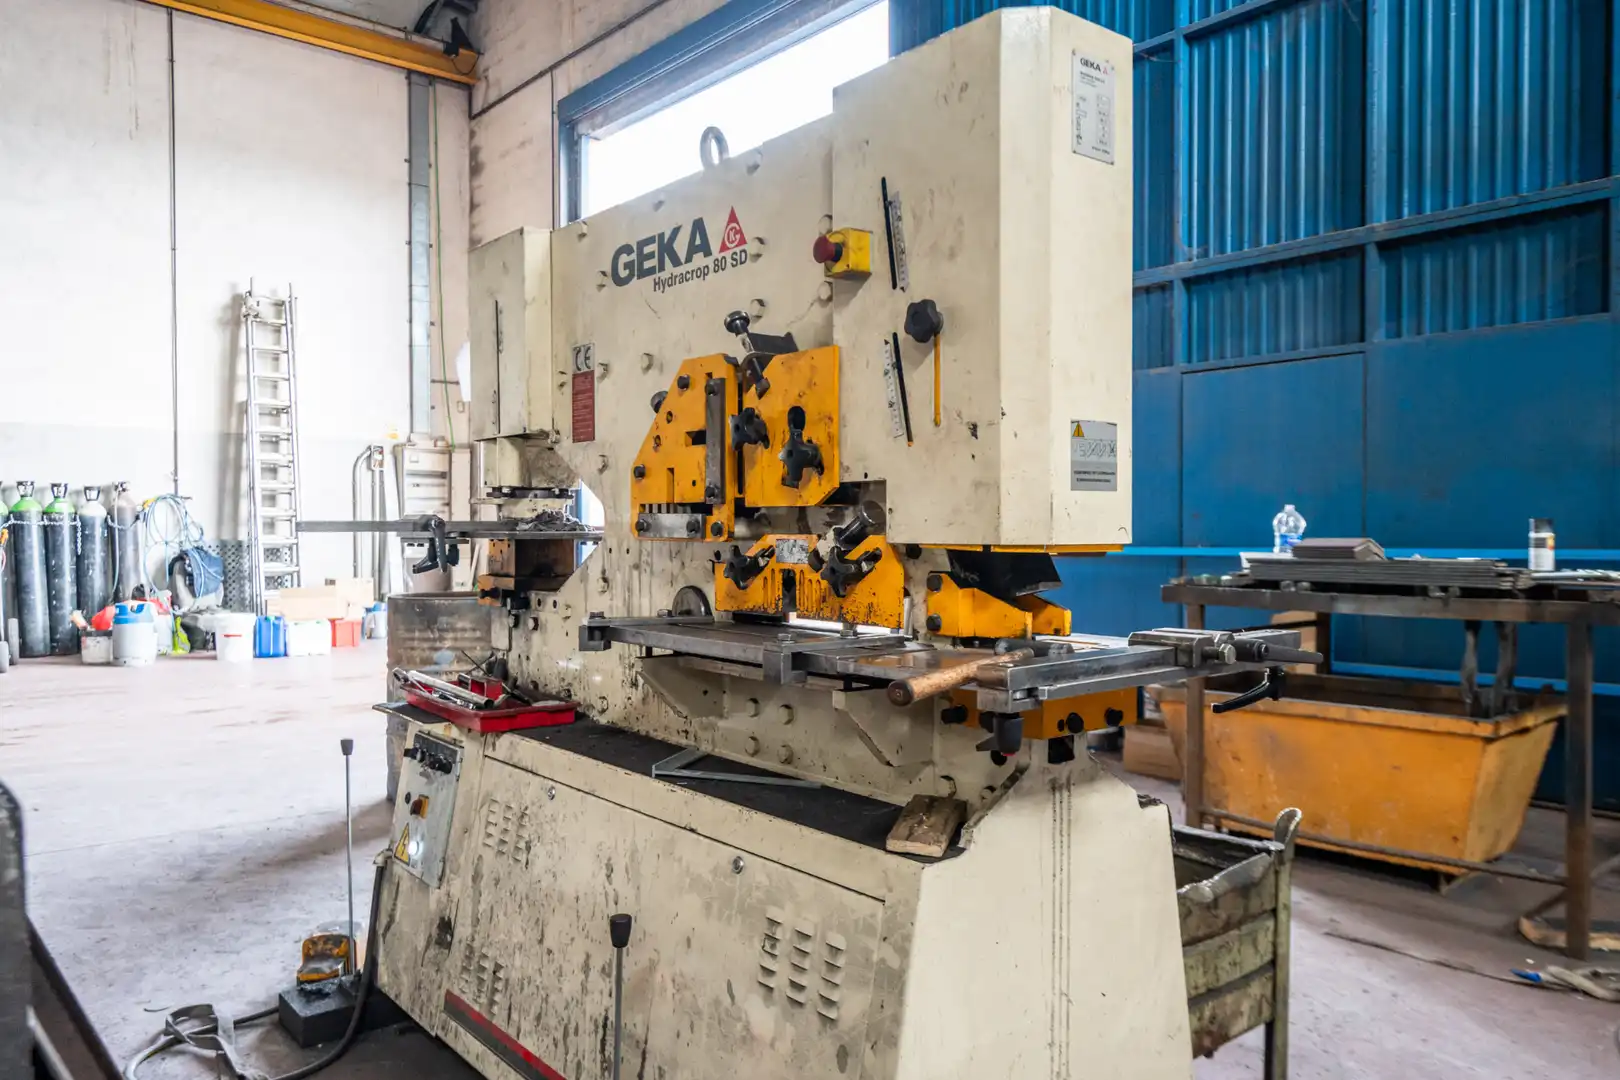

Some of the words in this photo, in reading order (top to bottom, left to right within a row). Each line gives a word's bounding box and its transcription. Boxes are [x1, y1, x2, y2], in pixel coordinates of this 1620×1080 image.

[1080, 57, 1101, 72] GEKA
[611, 216, 712, 287] GEKA
[653, 264, 710, 293] Hydracrop
[713, 255, 727, 275] 80
[731, 248, 748, 268] SD
